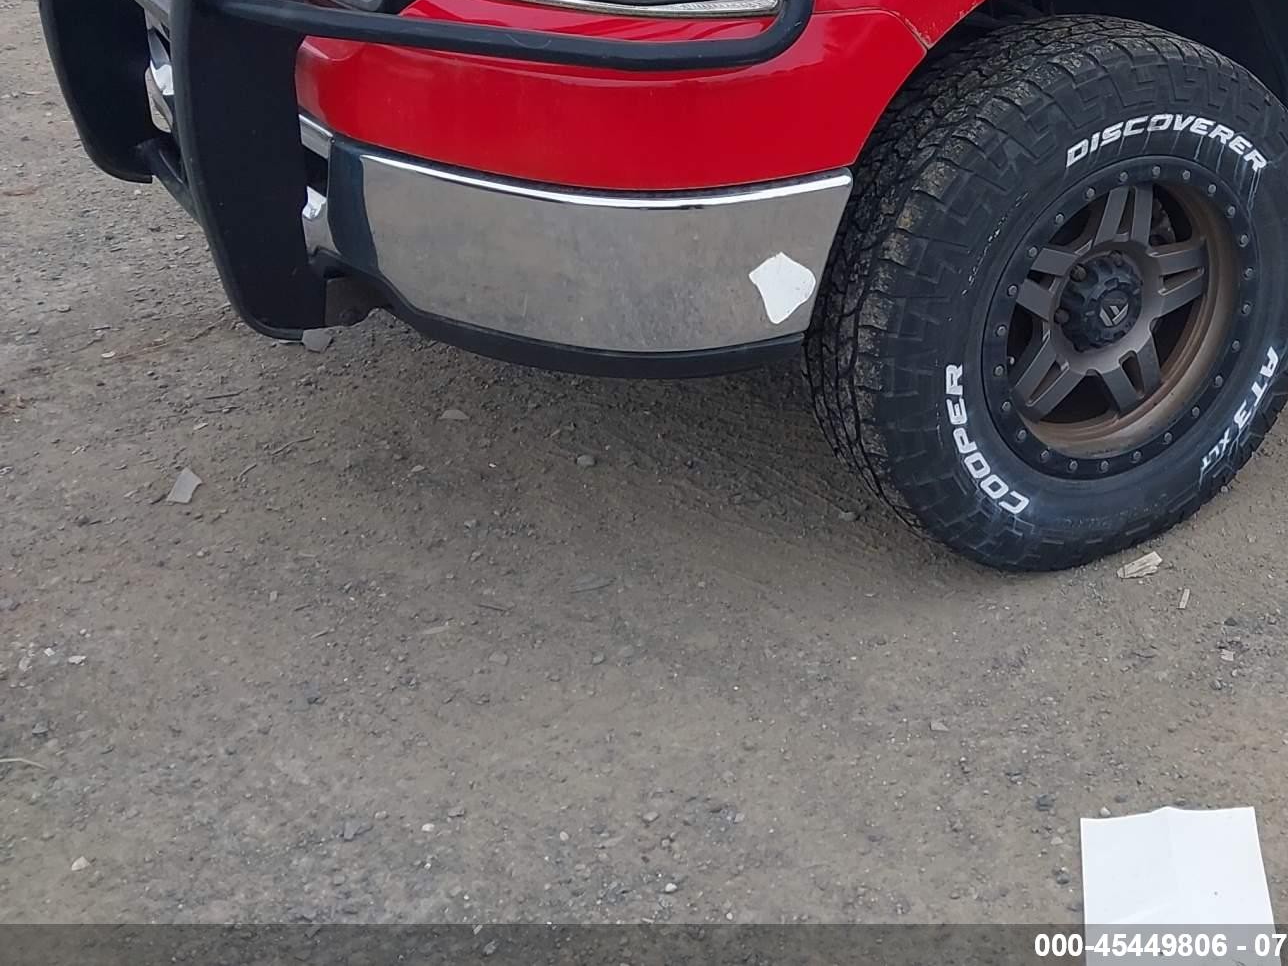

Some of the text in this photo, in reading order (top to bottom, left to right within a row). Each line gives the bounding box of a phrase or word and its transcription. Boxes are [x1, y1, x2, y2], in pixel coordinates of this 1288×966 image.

[1066, 114, 1268, 172] DISCOVERER
[1234, 346, 1279, 429] AT3
[946, 365, 1030, 514] COOPER
